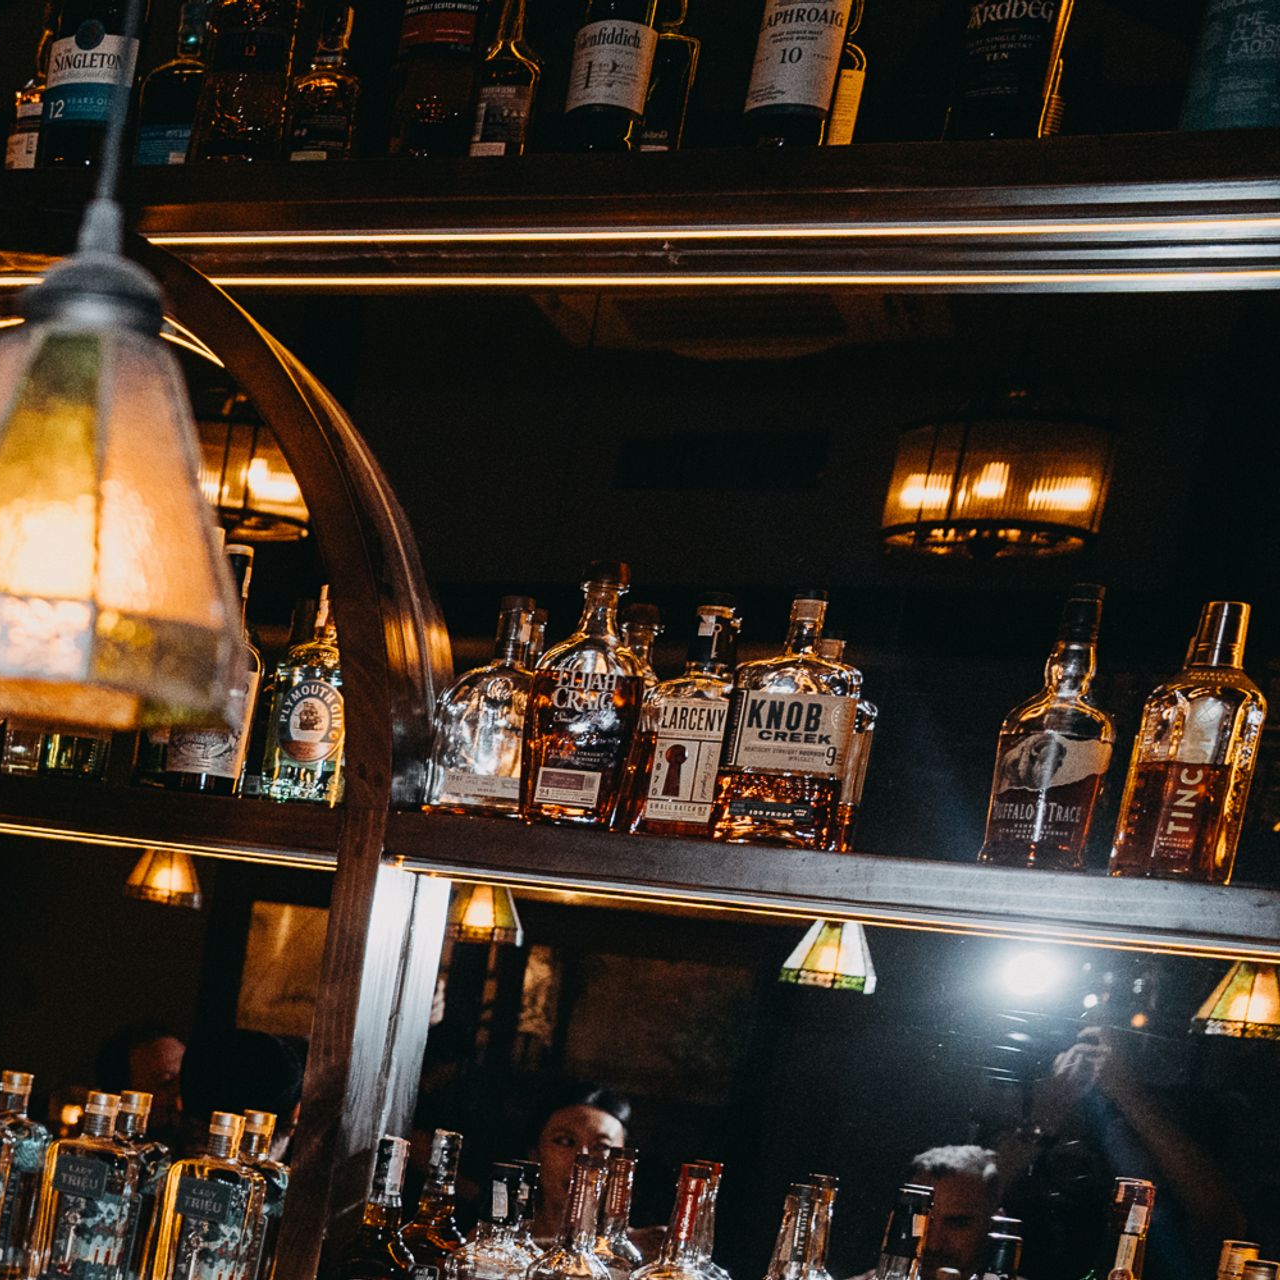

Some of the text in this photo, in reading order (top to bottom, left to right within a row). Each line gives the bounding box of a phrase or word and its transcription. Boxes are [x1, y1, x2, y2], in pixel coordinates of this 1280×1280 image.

[761, 7, 845, 32] LAPHROAIG
[780, 46, 802, 64] 10
[49, 98, 65, 120] 12
[554, 667, 618, 691] ELIJAH
[280, 684, 337, 722] PLYMOUTH
[552, 687, 615, 713] CRAIG
[661, 705, 726, 733] LARCENY
[746, 698, 824, 734] KNOB
[758, 729, 832, 745] CREEK
[825, 746, 837, 767] 9
[1046, 801, 1083, 823] TRACE
